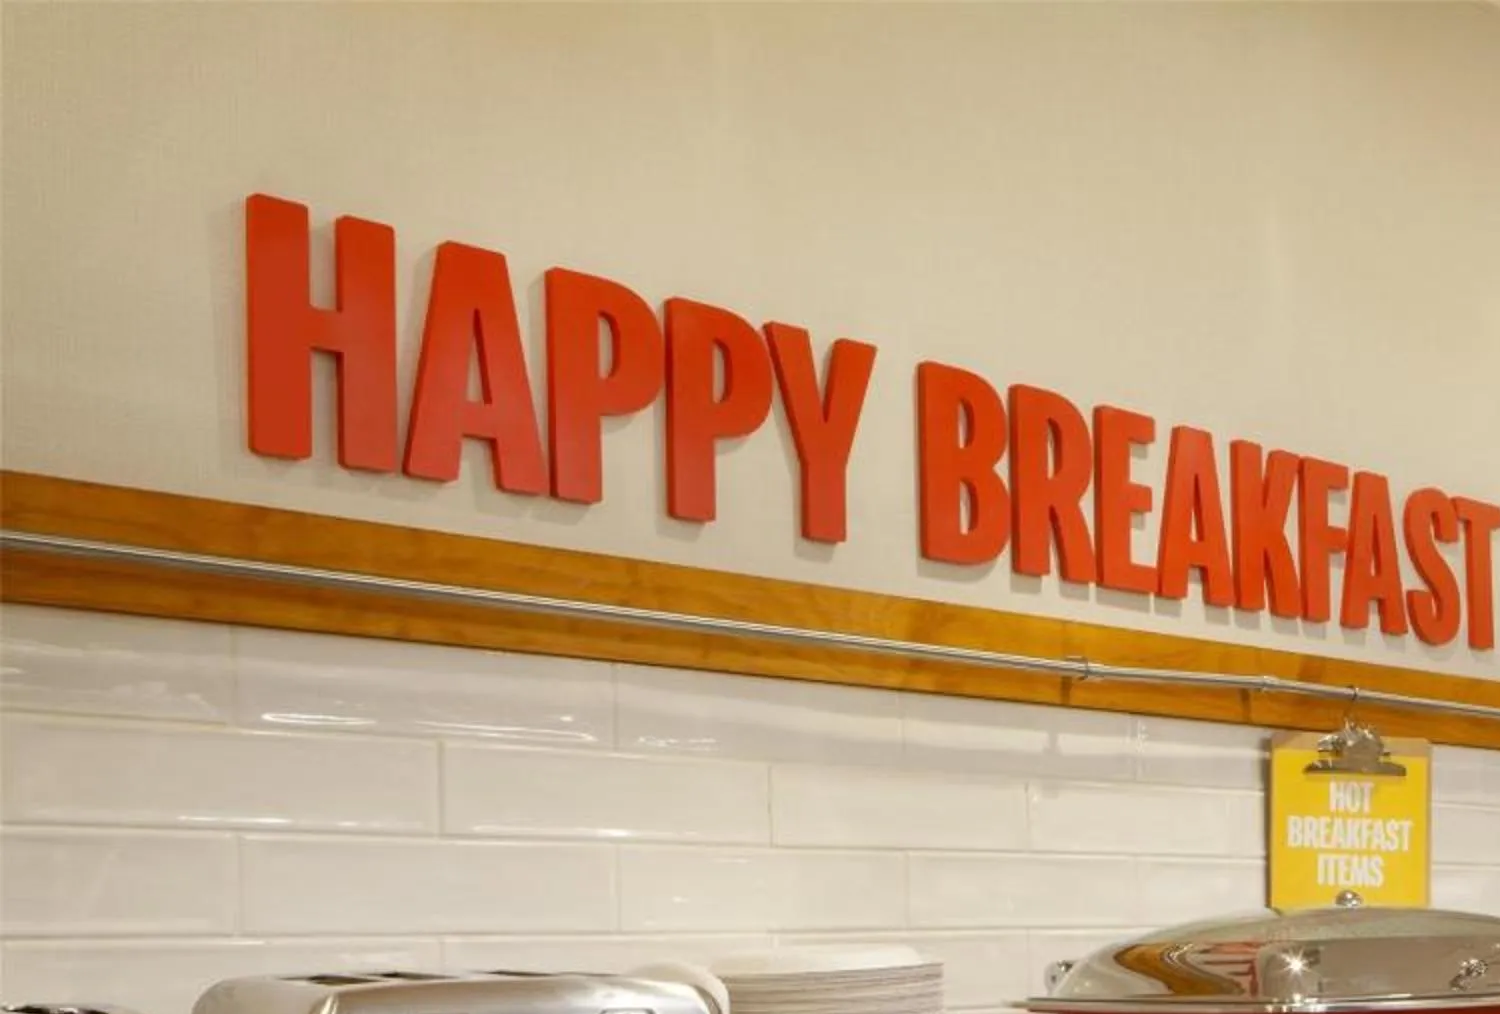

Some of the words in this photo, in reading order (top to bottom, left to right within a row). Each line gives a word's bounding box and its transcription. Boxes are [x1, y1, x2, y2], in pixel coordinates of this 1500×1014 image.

[246, 193, 877, 543] HAPPY
[1329, 780, 1374, 813] HOT
[1287, 815, 1414, 851] BREAKFAST
[1317, 853, 1384, 887] ITEMS
